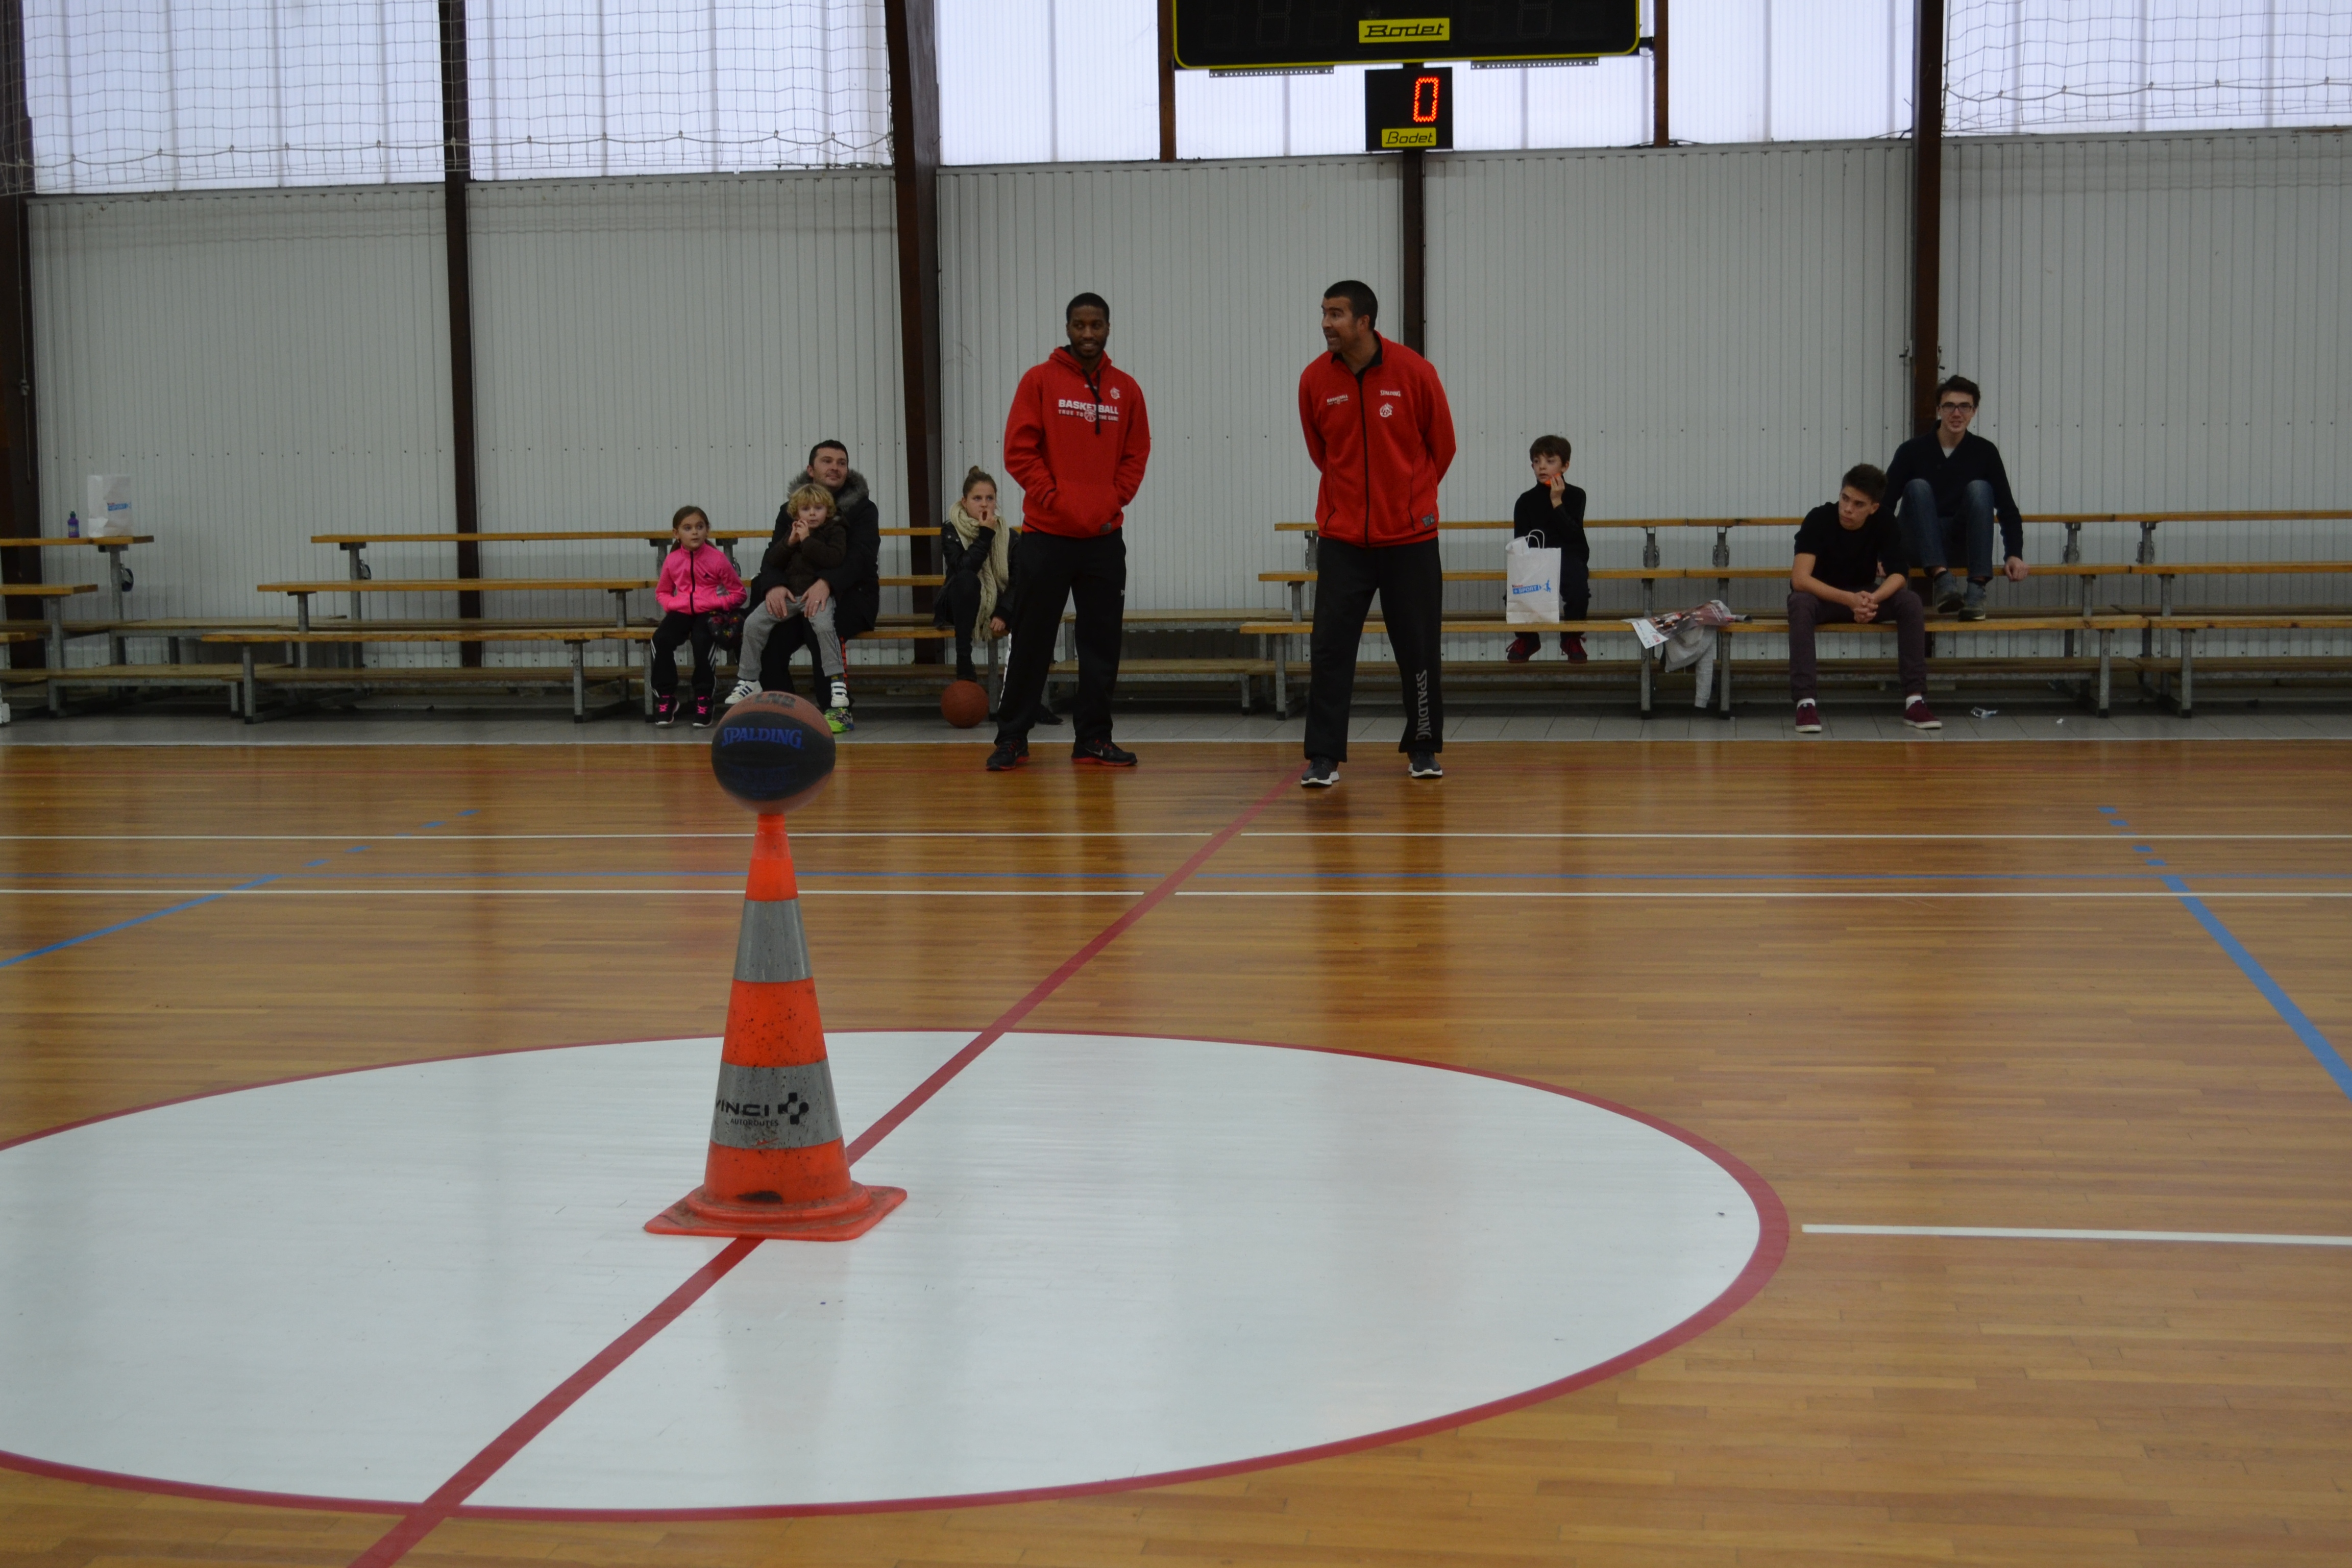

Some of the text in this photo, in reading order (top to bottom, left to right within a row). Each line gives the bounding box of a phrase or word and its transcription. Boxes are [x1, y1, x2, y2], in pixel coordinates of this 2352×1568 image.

[1364, 23, 1444, 38] Bodet
[1413, 77, 1439, 122] 0
[1385, 131, 1433, 144] Bodet
[1058, 399, 1119, 414] BASKETBALL
[1415, 669, 1432, 741] SPALDING
[721, 726, 803, 750] SPALDING
[730, 1118, 779, 1126] AUTOROUTES
